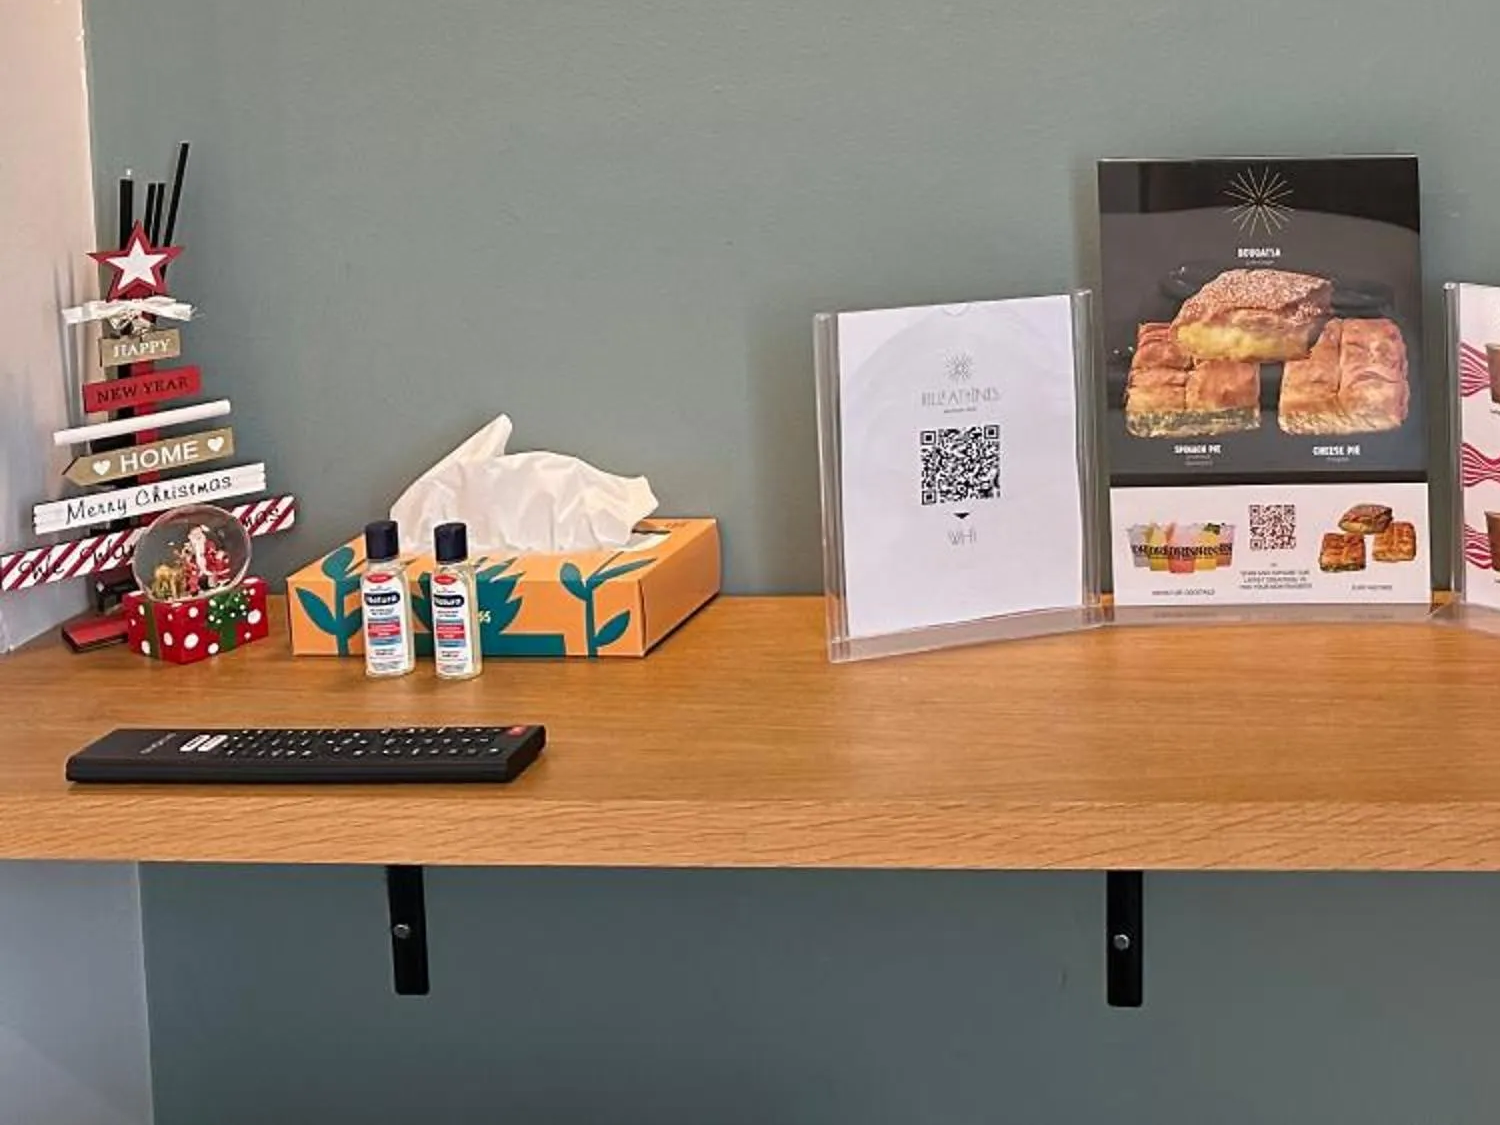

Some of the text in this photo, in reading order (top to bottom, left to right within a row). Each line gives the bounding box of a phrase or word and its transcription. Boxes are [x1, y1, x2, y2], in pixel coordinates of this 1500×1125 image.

[113, 338, 171, 358] HAPPY
[96, 376, 189, 404] NEW YEAR
[120, 440, 199, 473] HOME
[66, 476, 232, 525] Merry Christmas
